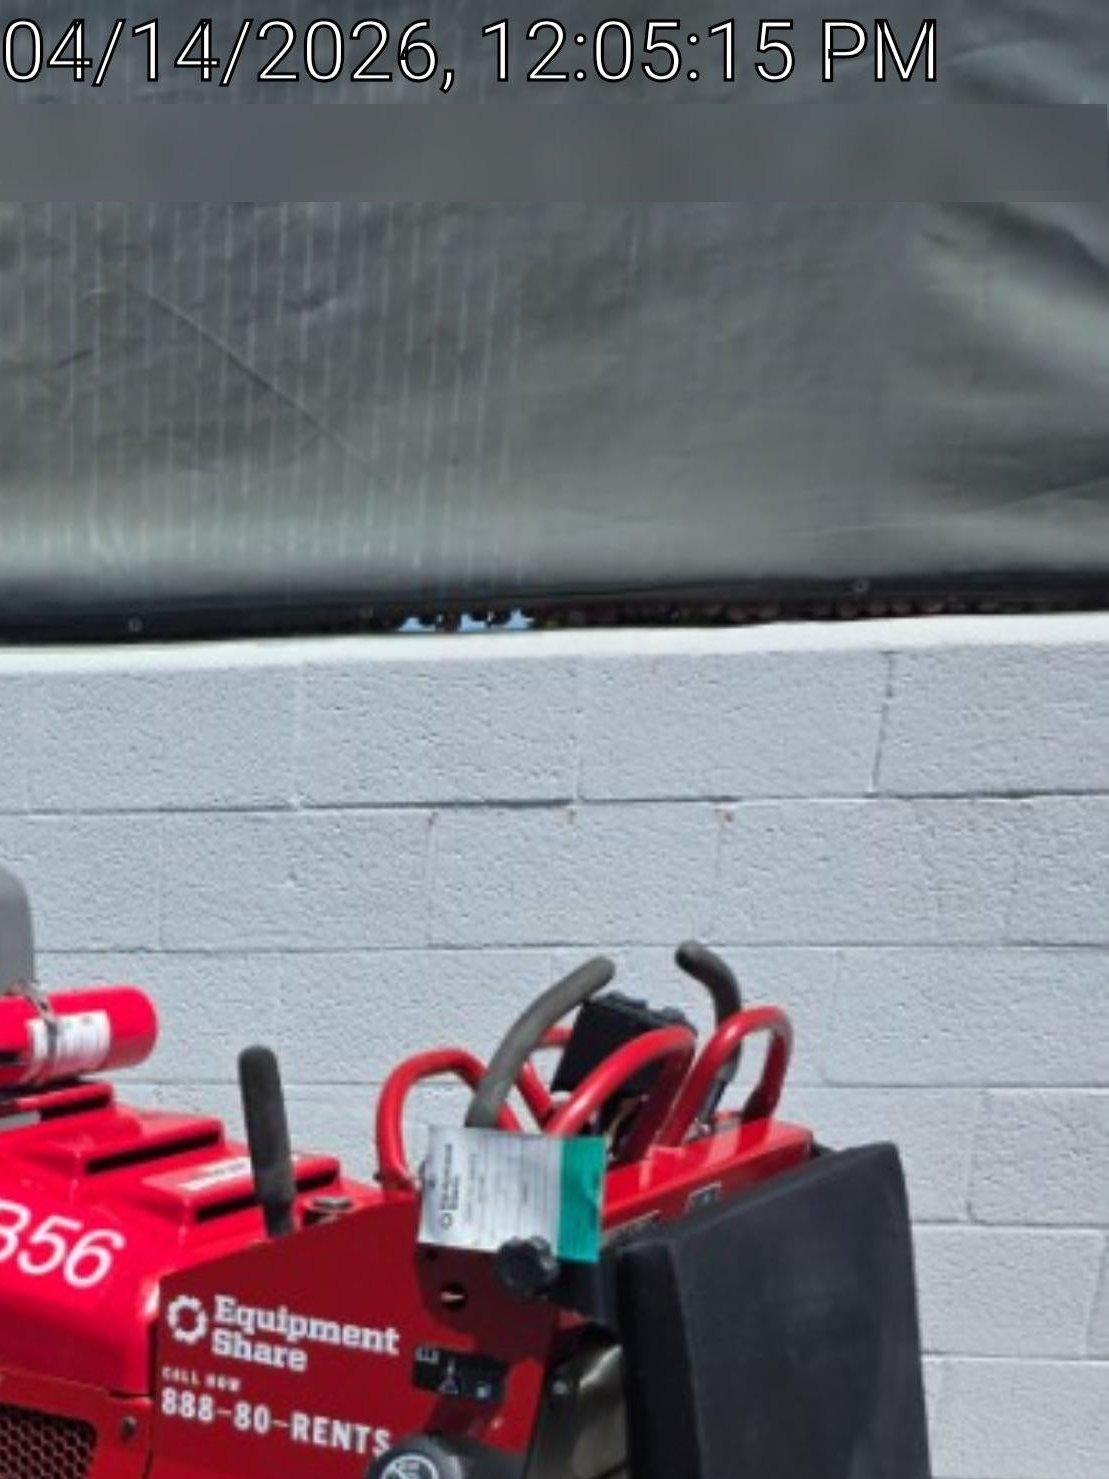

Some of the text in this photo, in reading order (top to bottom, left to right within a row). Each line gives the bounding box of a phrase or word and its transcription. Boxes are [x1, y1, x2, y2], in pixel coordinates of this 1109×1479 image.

[211, 1328, 308, 1373] Share
[213, 1294, 400, 1356] Equipment
[161, 1387, 393, 1456] 888-80-RENTS
